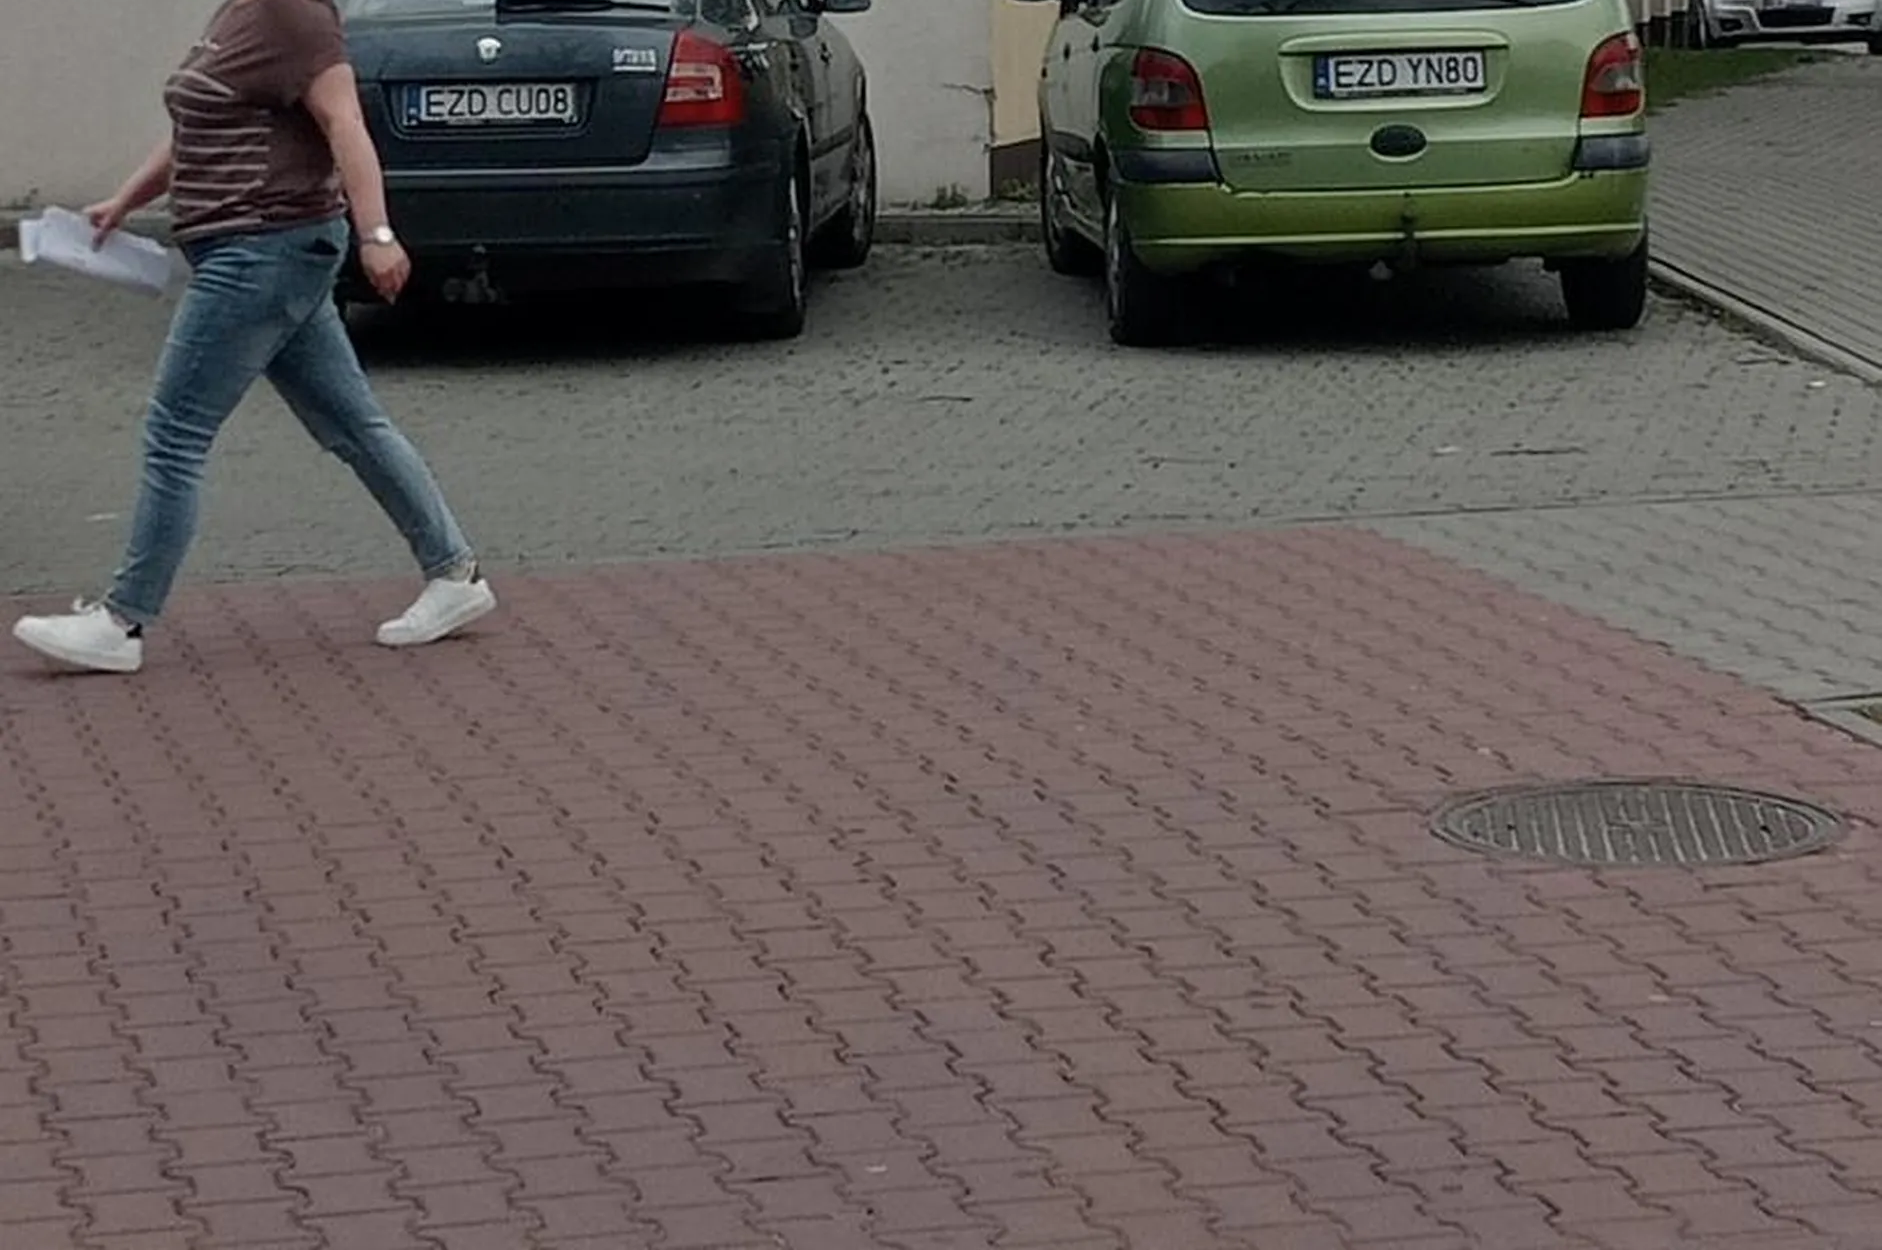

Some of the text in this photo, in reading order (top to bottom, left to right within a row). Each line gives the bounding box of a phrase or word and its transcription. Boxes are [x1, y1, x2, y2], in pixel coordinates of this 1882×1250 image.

[1334, 56, 1479, 88] EZD YN80
[425, 87, 569, 117] EZD CU08
